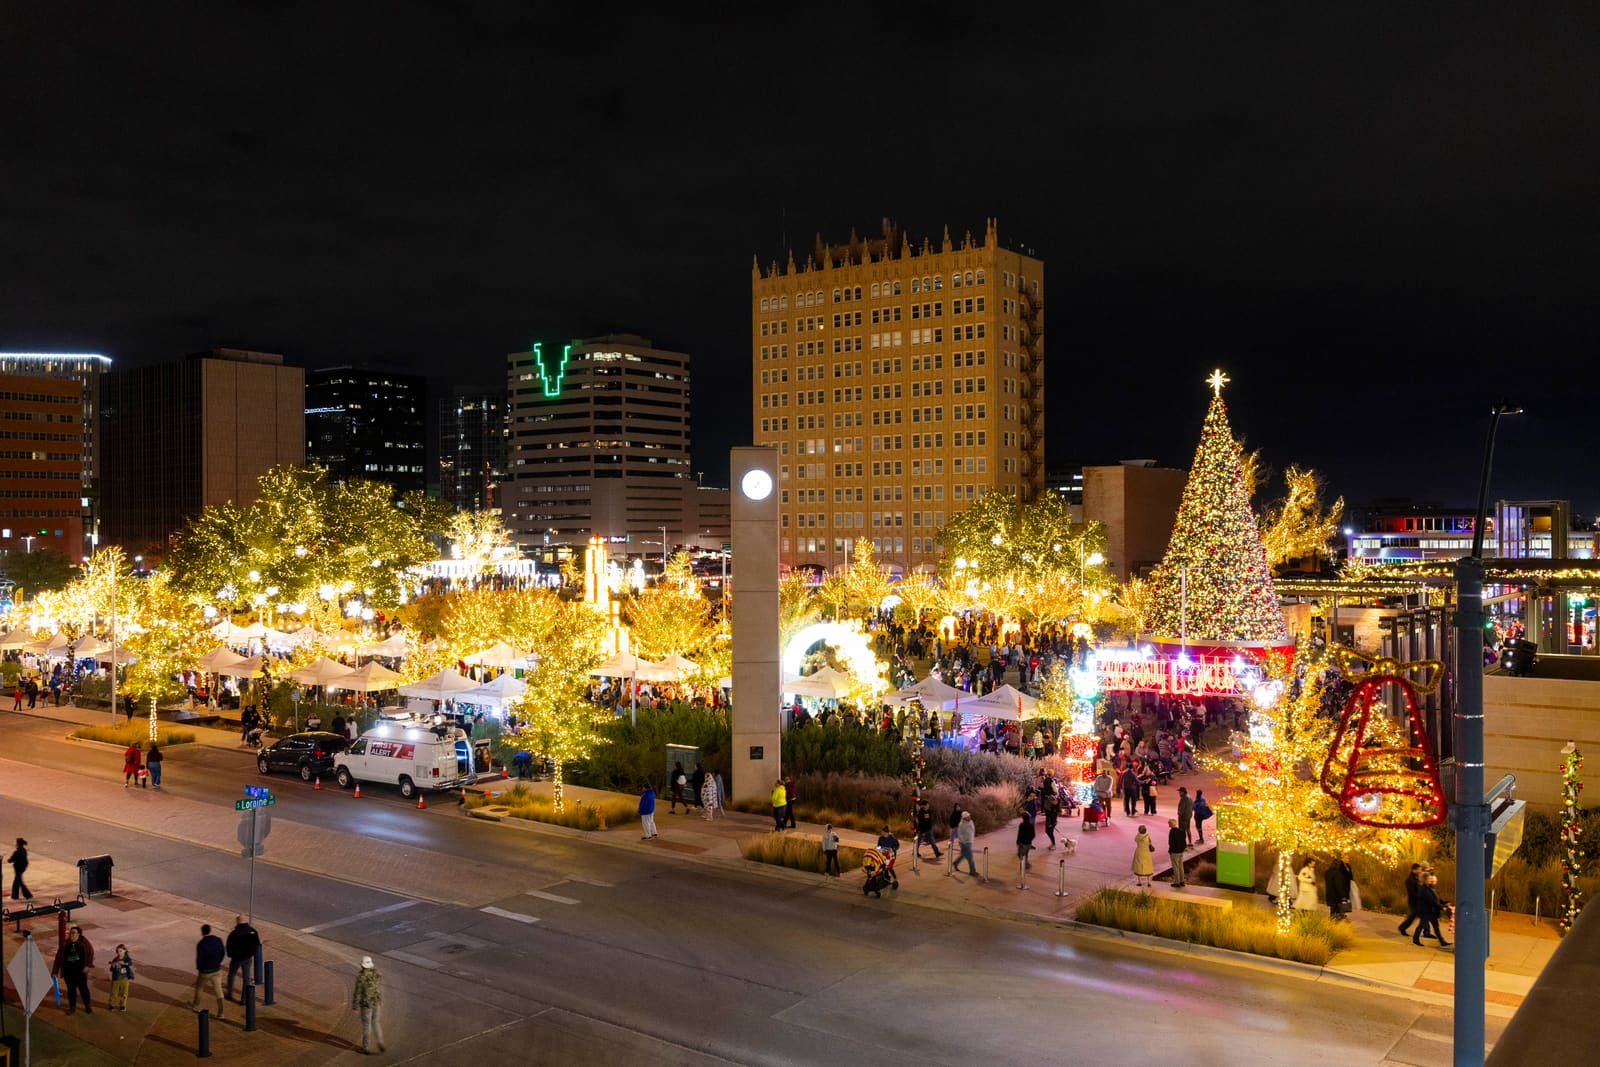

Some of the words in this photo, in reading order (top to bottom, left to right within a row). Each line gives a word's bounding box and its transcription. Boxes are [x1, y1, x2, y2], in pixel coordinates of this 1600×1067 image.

[1171, 655, 1234, 696] Lights
[371, 748, 391, 757] ALERT
[392, 743, 403, 758] 7
[241, 799, 268, 809] Loraine
